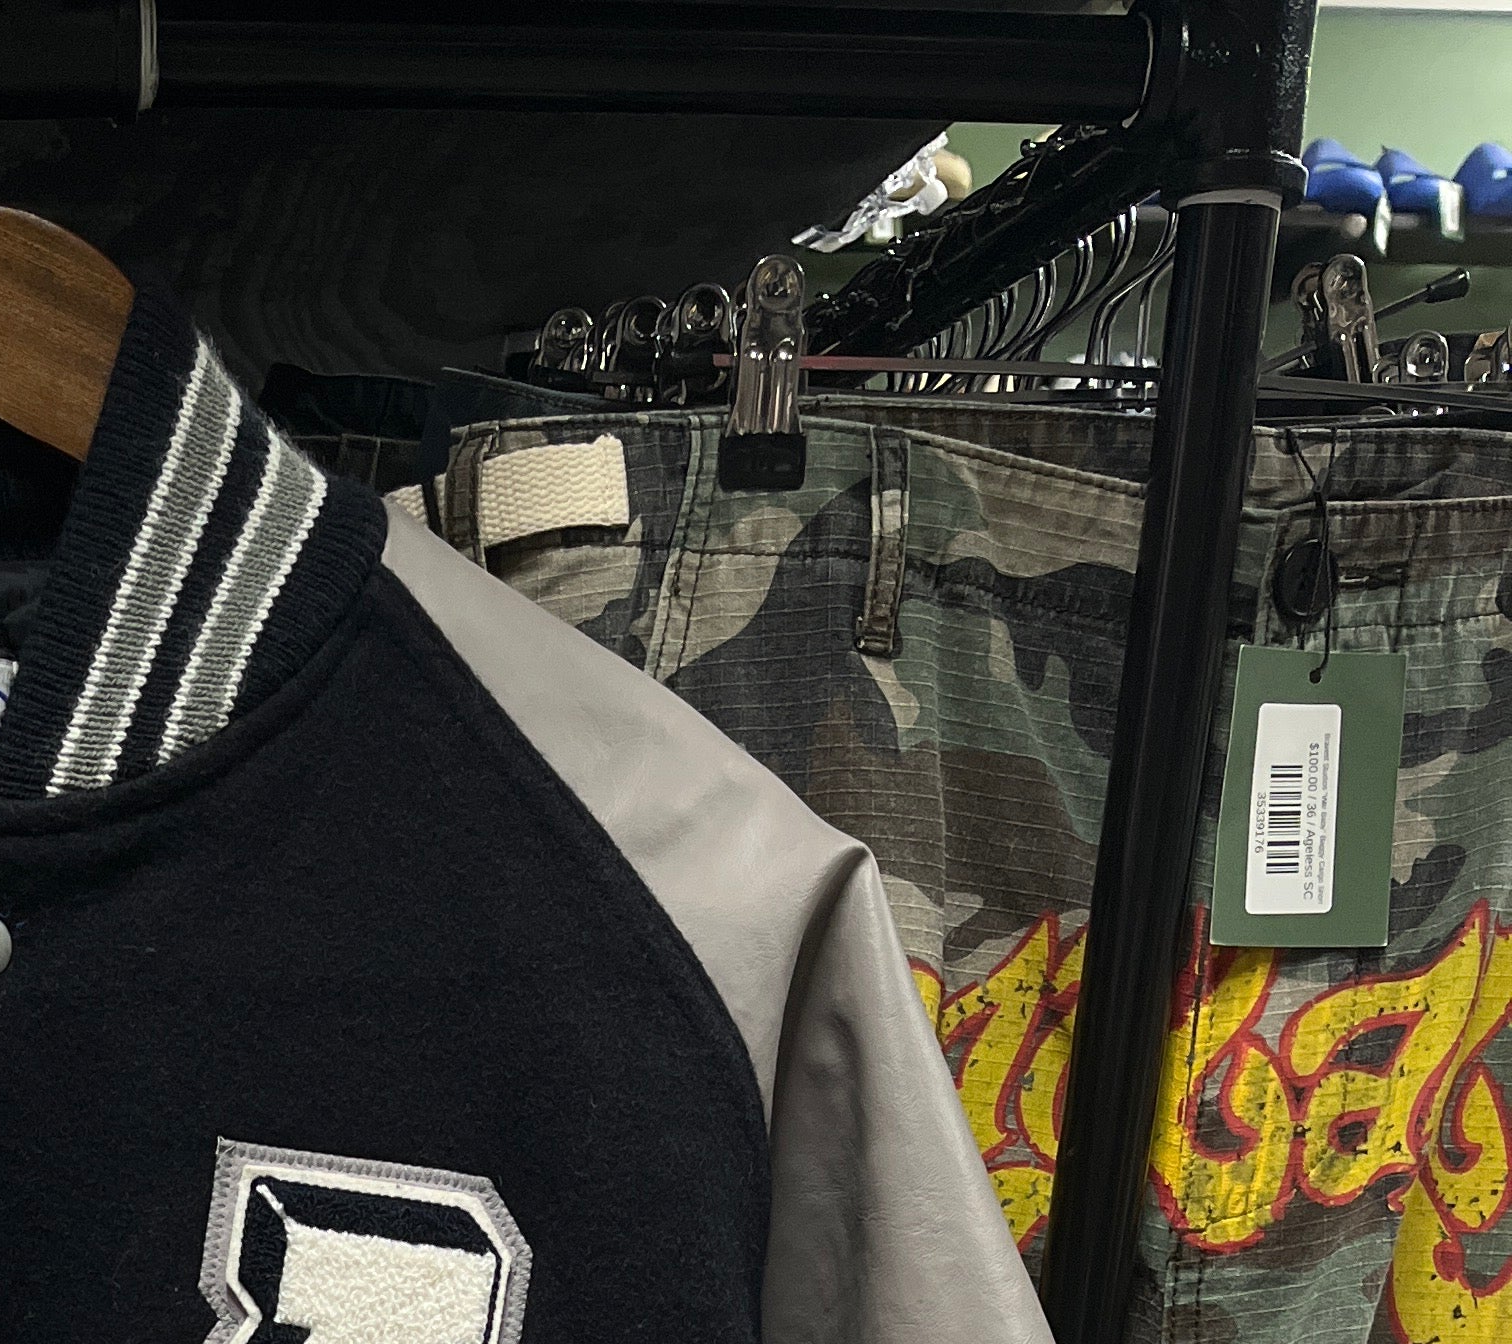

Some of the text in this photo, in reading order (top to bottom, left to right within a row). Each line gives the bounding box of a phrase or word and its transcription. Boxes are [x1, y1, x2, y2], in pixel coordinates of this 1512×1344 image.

[1308, 742, 1320, 792] $100.00
[1254, 791, 1267, 854] 35339176
[1306, 803, 1317, 818] 36
[1303, 829, 1316, 878] Ageless
[1303, 882, 1314, 900] SC
